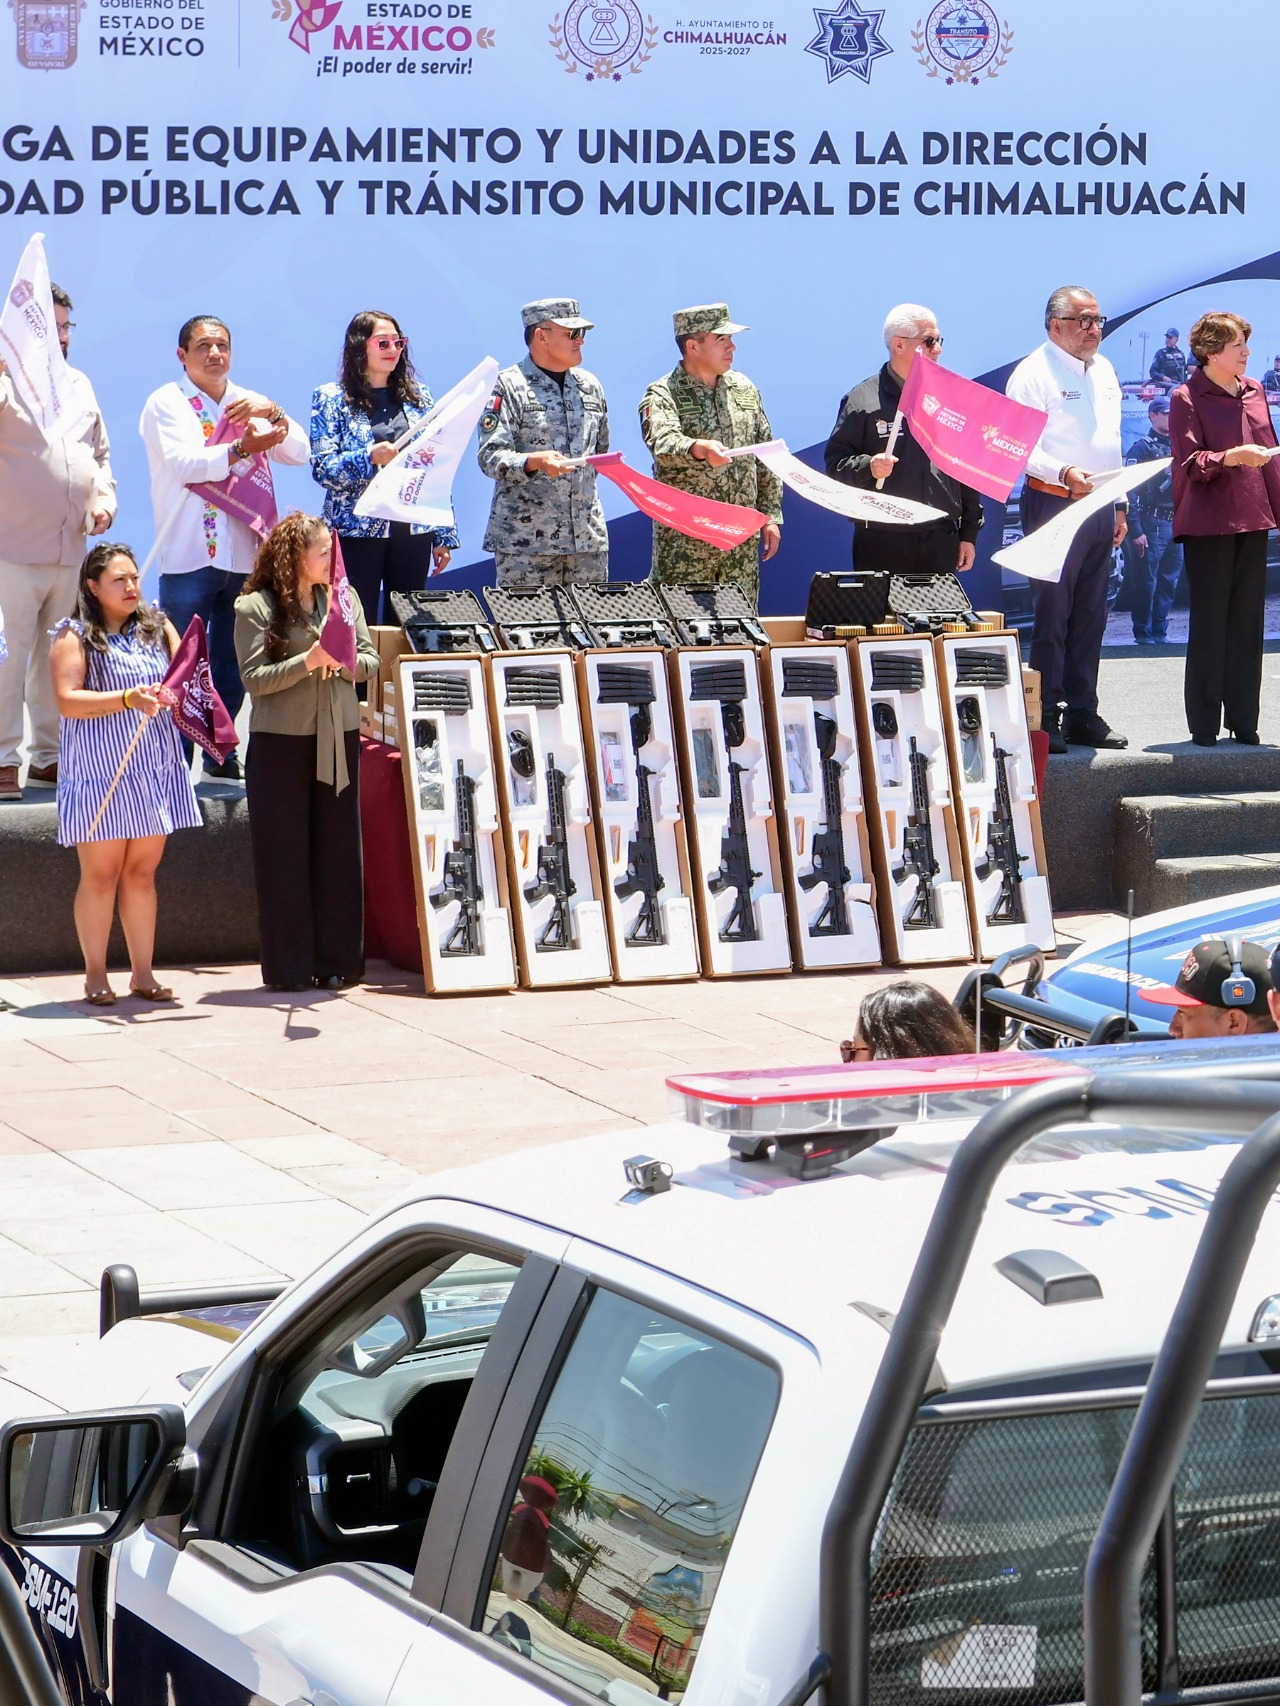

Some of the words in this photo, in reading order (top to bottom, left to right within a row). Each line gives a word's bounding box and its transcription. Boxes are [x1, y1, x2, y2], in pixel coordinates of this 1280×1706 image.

[366, 3, 442, 18] ESTADO
[447, 5, 472, 19] DE
[100, 16, 174, 30] ESTADO
[181, 17, 205, 30] DE
[675, 19, 685, 28] H.
[689, 20, 759, 29] AYUNTAMIENTO
[763, 21, 774, 29] DE
[99, 32, 205, 57] MÉXICO
[333, 22, 472, 52] MÉXICO
[663, 30, 787, 46] CHIMALHUACÁN
[699, 46, 751, 56] 2025-2027
[317, 56, 338, 77] ¡El
[343, 57, 392, 77] poder
[396, 57, 416, 74] de
[421, 57, 472, 75] servir!
[2, 125, 75, 163] GA
[91, 125, 150, 163] DE
[166, 126, 522, 168] EQUIPAMIENTO
[537, 128, 565, 164] Y
[577, 129, 796, 166] UNIDADES
[809, 131, 842, 165] A
[855, 131, 908, 166] LA
[922, 123, 1147, 167] DIRECCIÓN
[101, 170, 301, 216] PÚBLICA
[316, 180, 345, 216] Y
[358, 170, 584, 216] TRÁNSITO
[600, 179, 836, 216] MUNICIPAL
[848, 181, 899, 216] DE
[913, 172, 1246, 217] CHIMALHUACÁN
